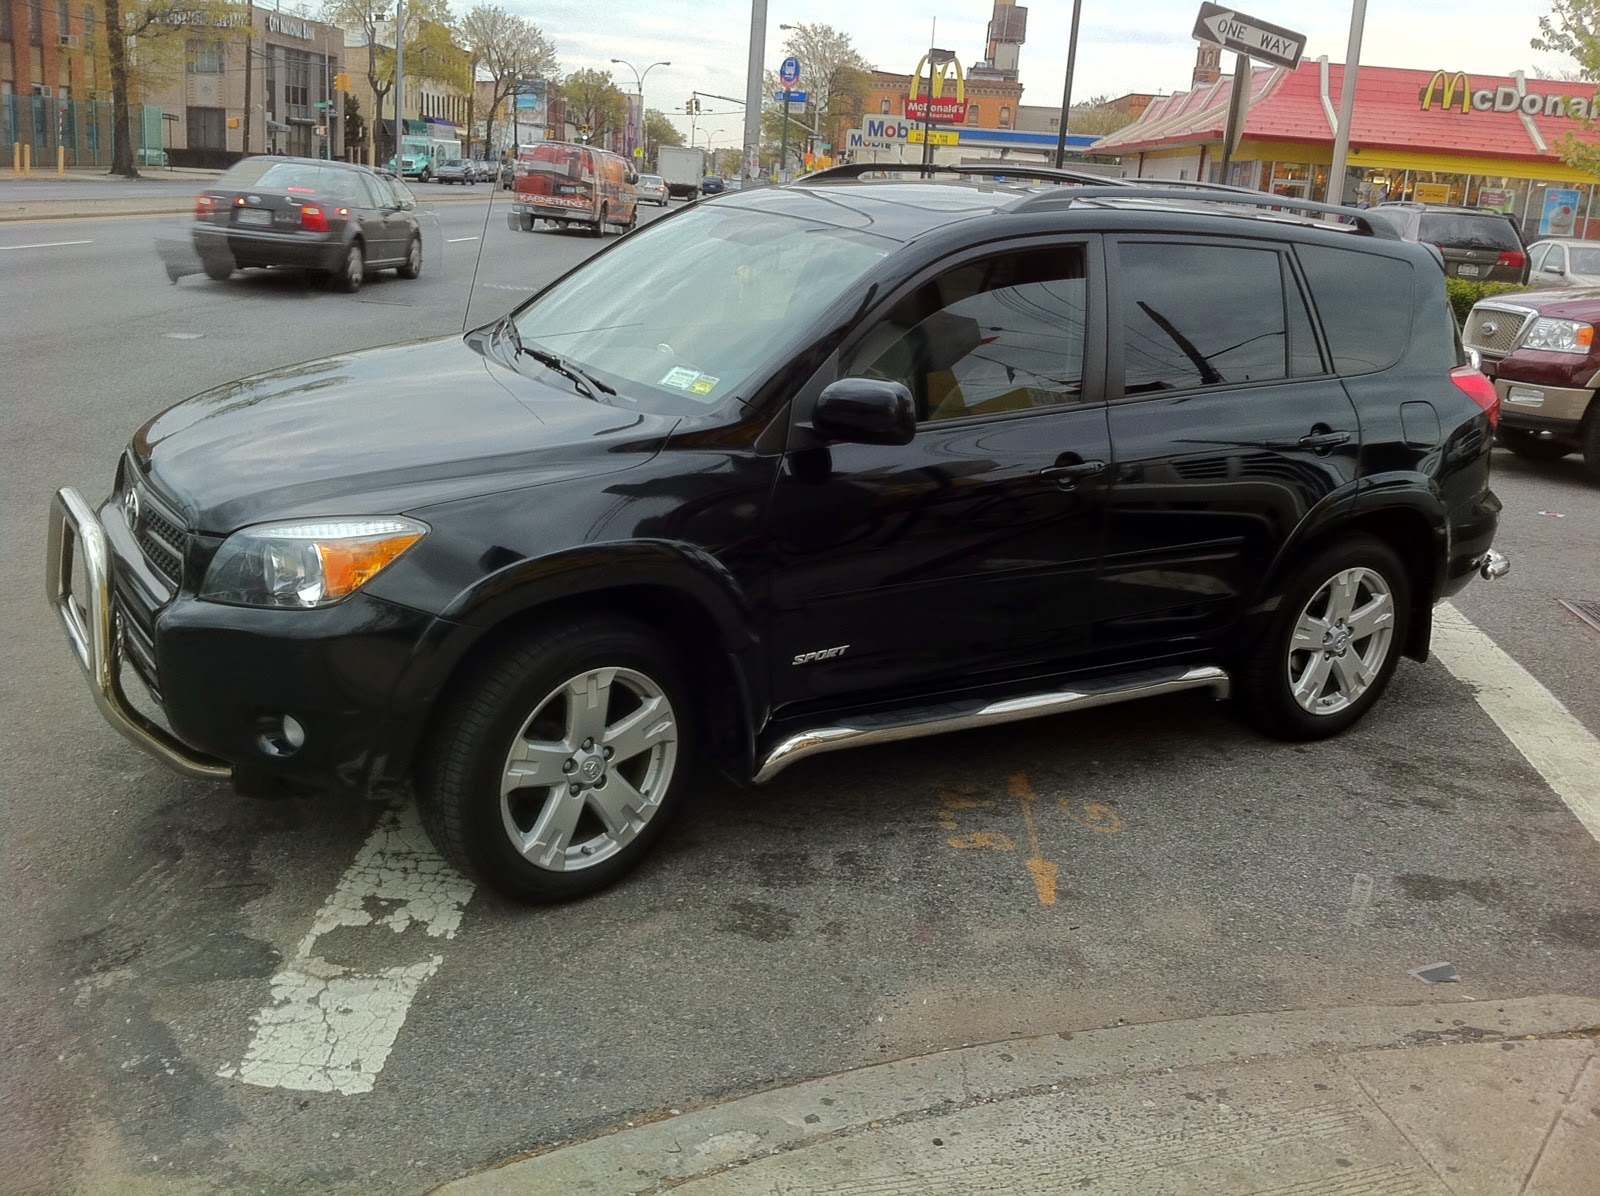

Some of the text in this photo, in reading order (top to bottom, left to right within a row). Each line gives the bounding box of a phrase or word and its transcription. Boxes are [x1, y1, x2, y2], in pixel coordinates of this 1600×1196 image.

[1217, 19, 1292, 55] ONE WAY
[916, 111, 954, 119] Retaurant
[792, 644, 850, 666] SPORT
